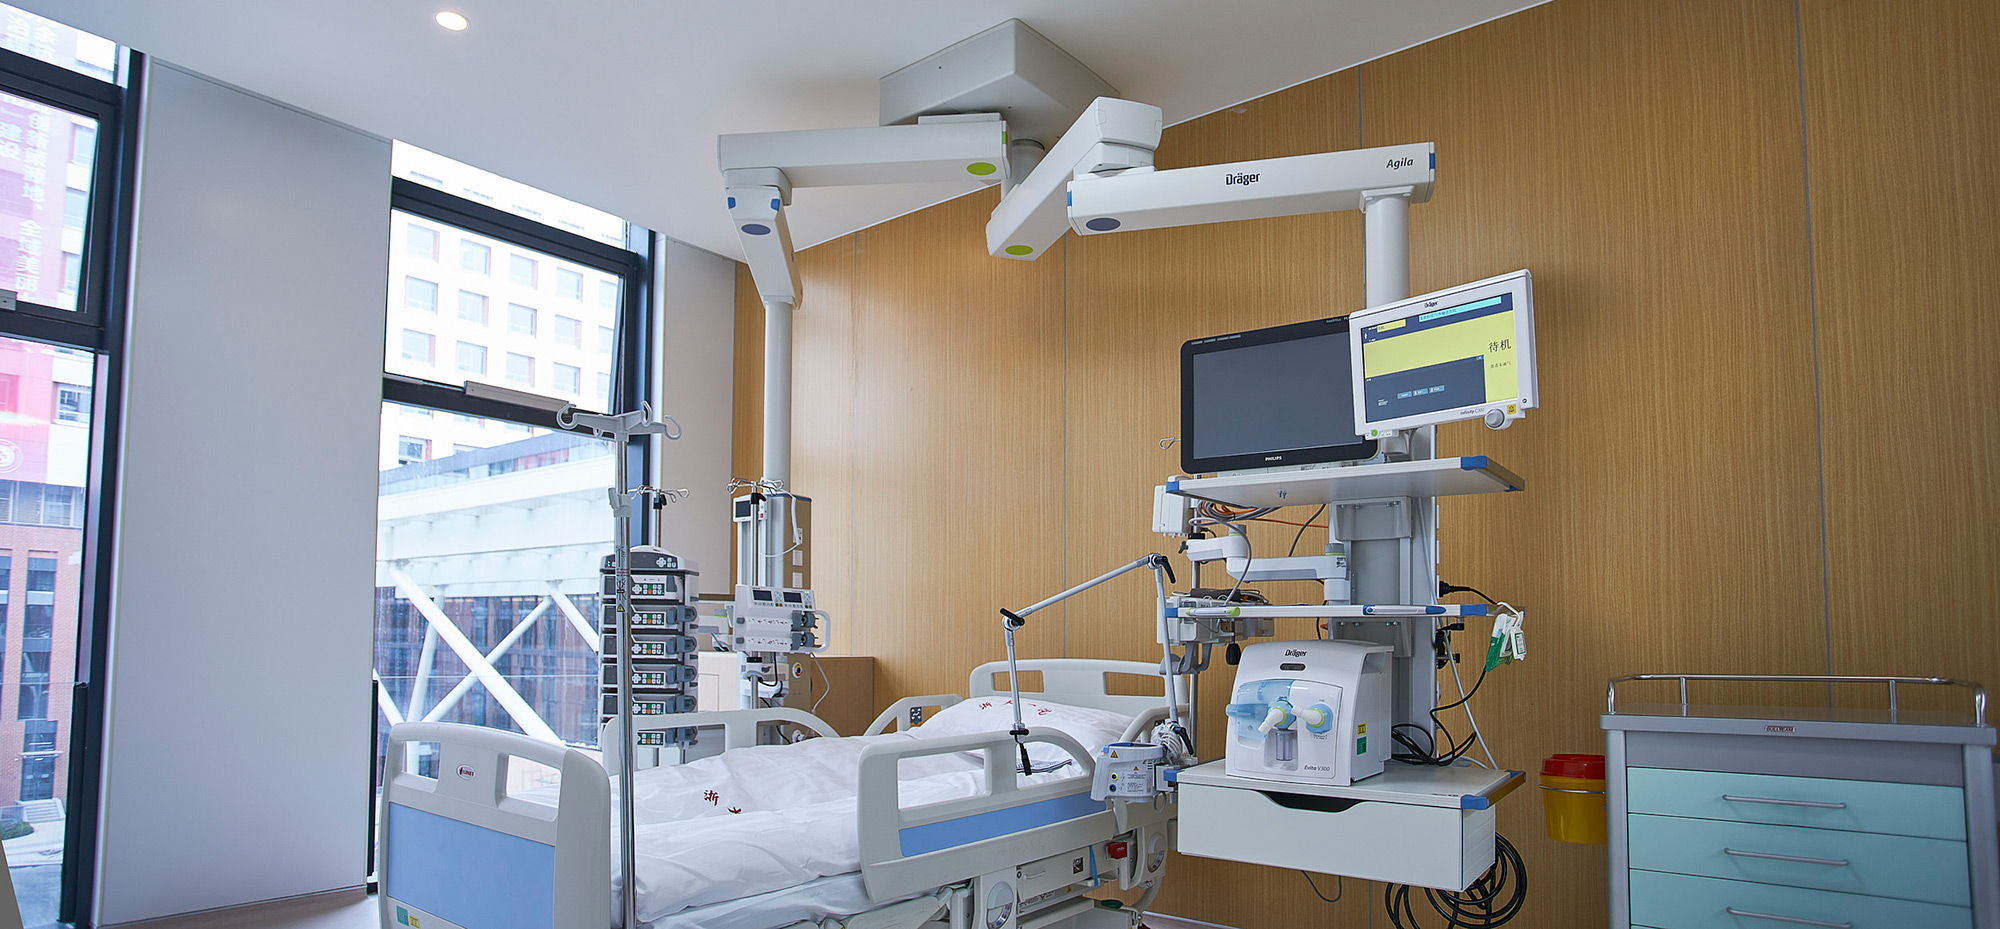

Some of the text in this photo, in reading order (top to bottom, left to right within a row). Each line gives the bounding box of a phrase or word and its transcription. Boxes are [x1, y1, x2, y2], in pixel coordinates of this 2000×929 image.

[1386, 157, 1414, 170] Agila
[1225, 172, 1260, 186] Dräger
[1488, 338, 1512, 353] 待机
[1285, 649, 1307, 657] Dräger
